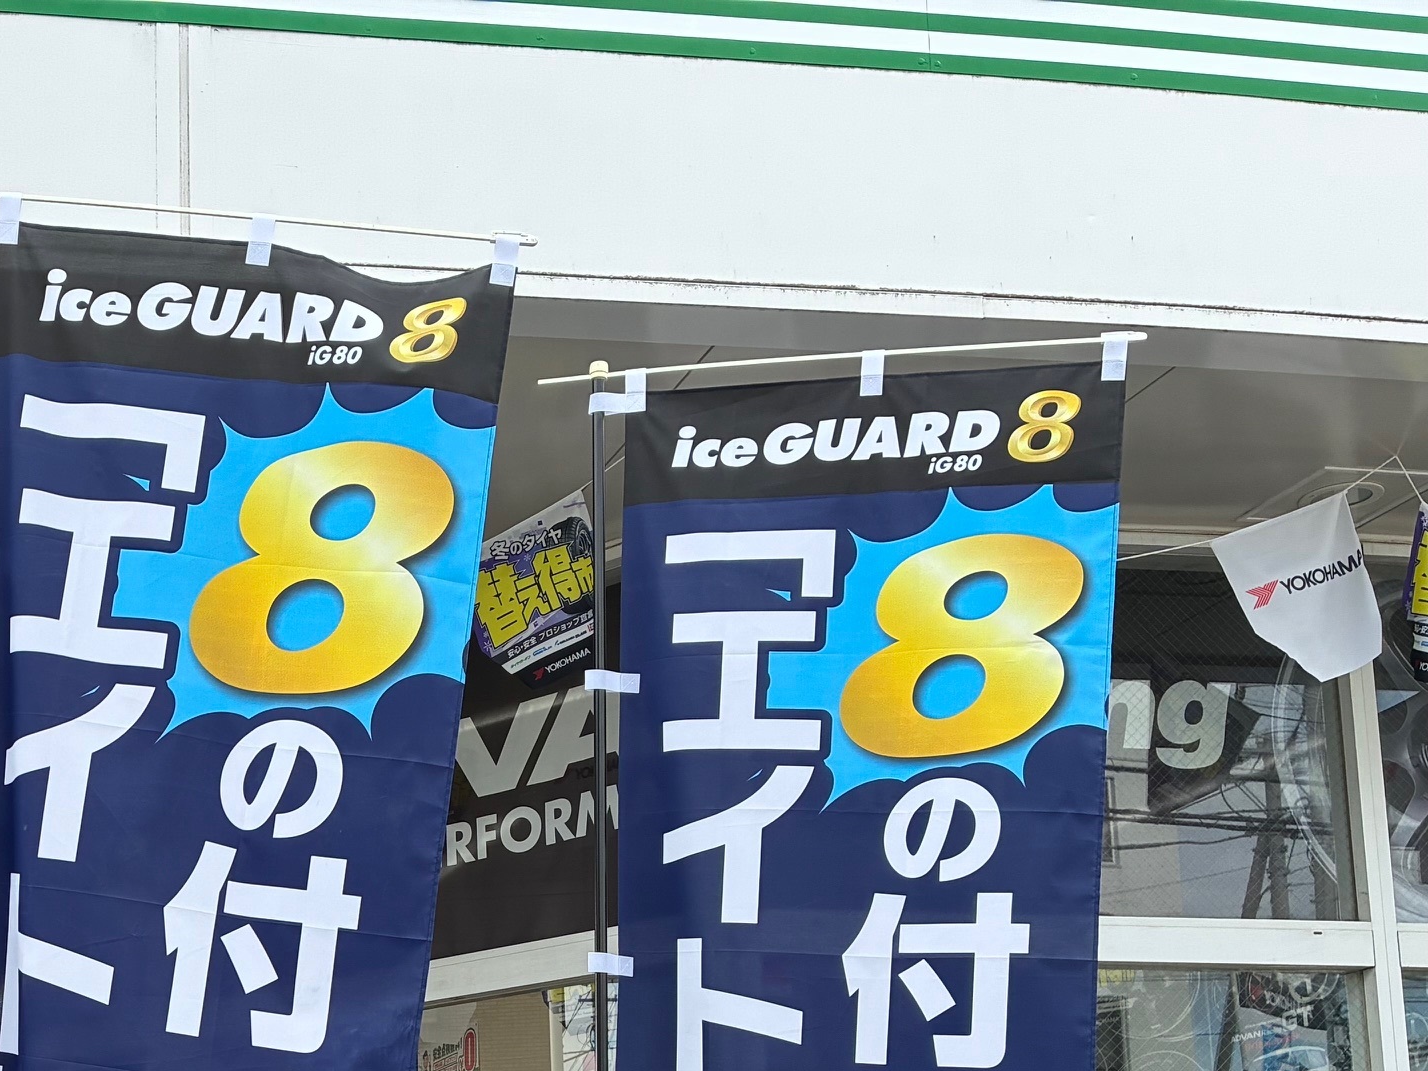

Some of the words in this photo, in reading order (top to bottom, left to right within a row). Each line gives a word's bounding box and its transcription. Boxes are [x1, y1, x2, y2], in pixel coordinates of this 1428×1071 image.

[39, 269, 384, 345] iceGUARD
[388, 297, 467, 363] 8
[307, 344, 363, 367] iG80
[672, 409, 1001, 468] iceGUARD
[1007, 390, 1082, 463] 8
[927, 454, 983, 475] iG80
[490, 527, 562, 561] 冬のタイヤ
[544, 646, 592, 674] YOKOHAMA
